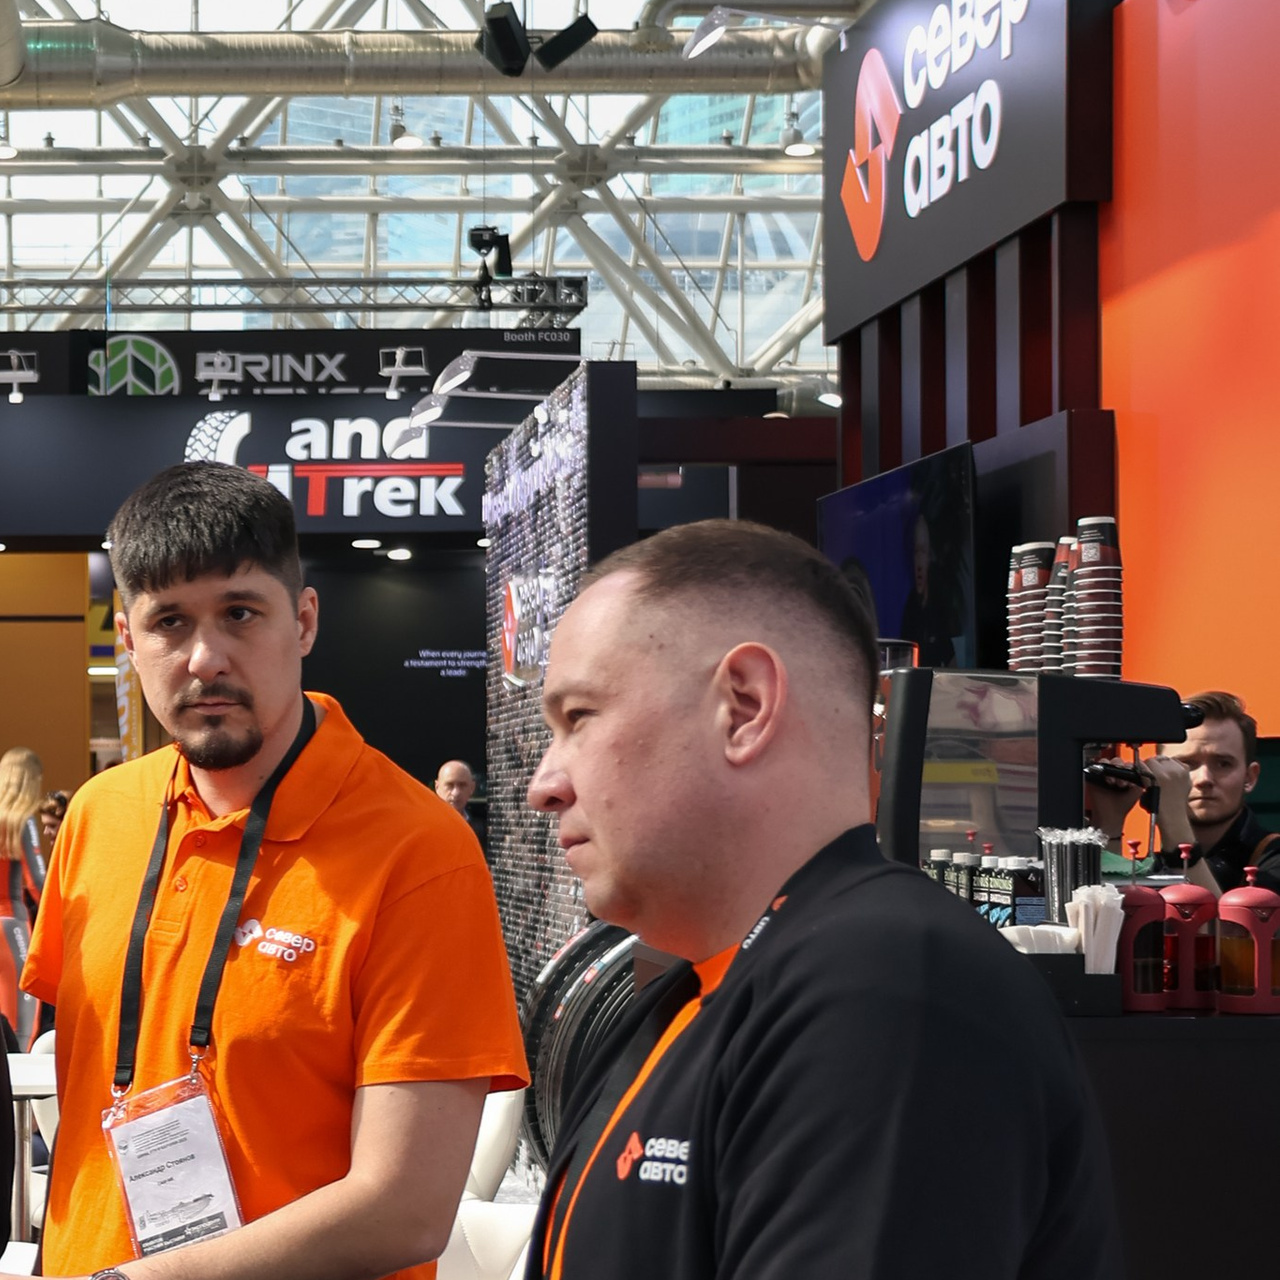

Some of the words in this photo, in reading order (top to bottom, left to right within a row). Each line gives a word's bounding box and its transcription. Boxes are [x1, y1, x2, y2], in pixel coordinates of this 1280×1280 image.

[903, 78, 1003, 219] авто
[504, 332, 535, 342] Booth
[538, 332, 570, 342] FC030
[463, 650, 487, 659] journe
[257, 941, 297, 962] авто
[265, 927, 315, 954] север
[644, 1137, 690, 1161] севе
